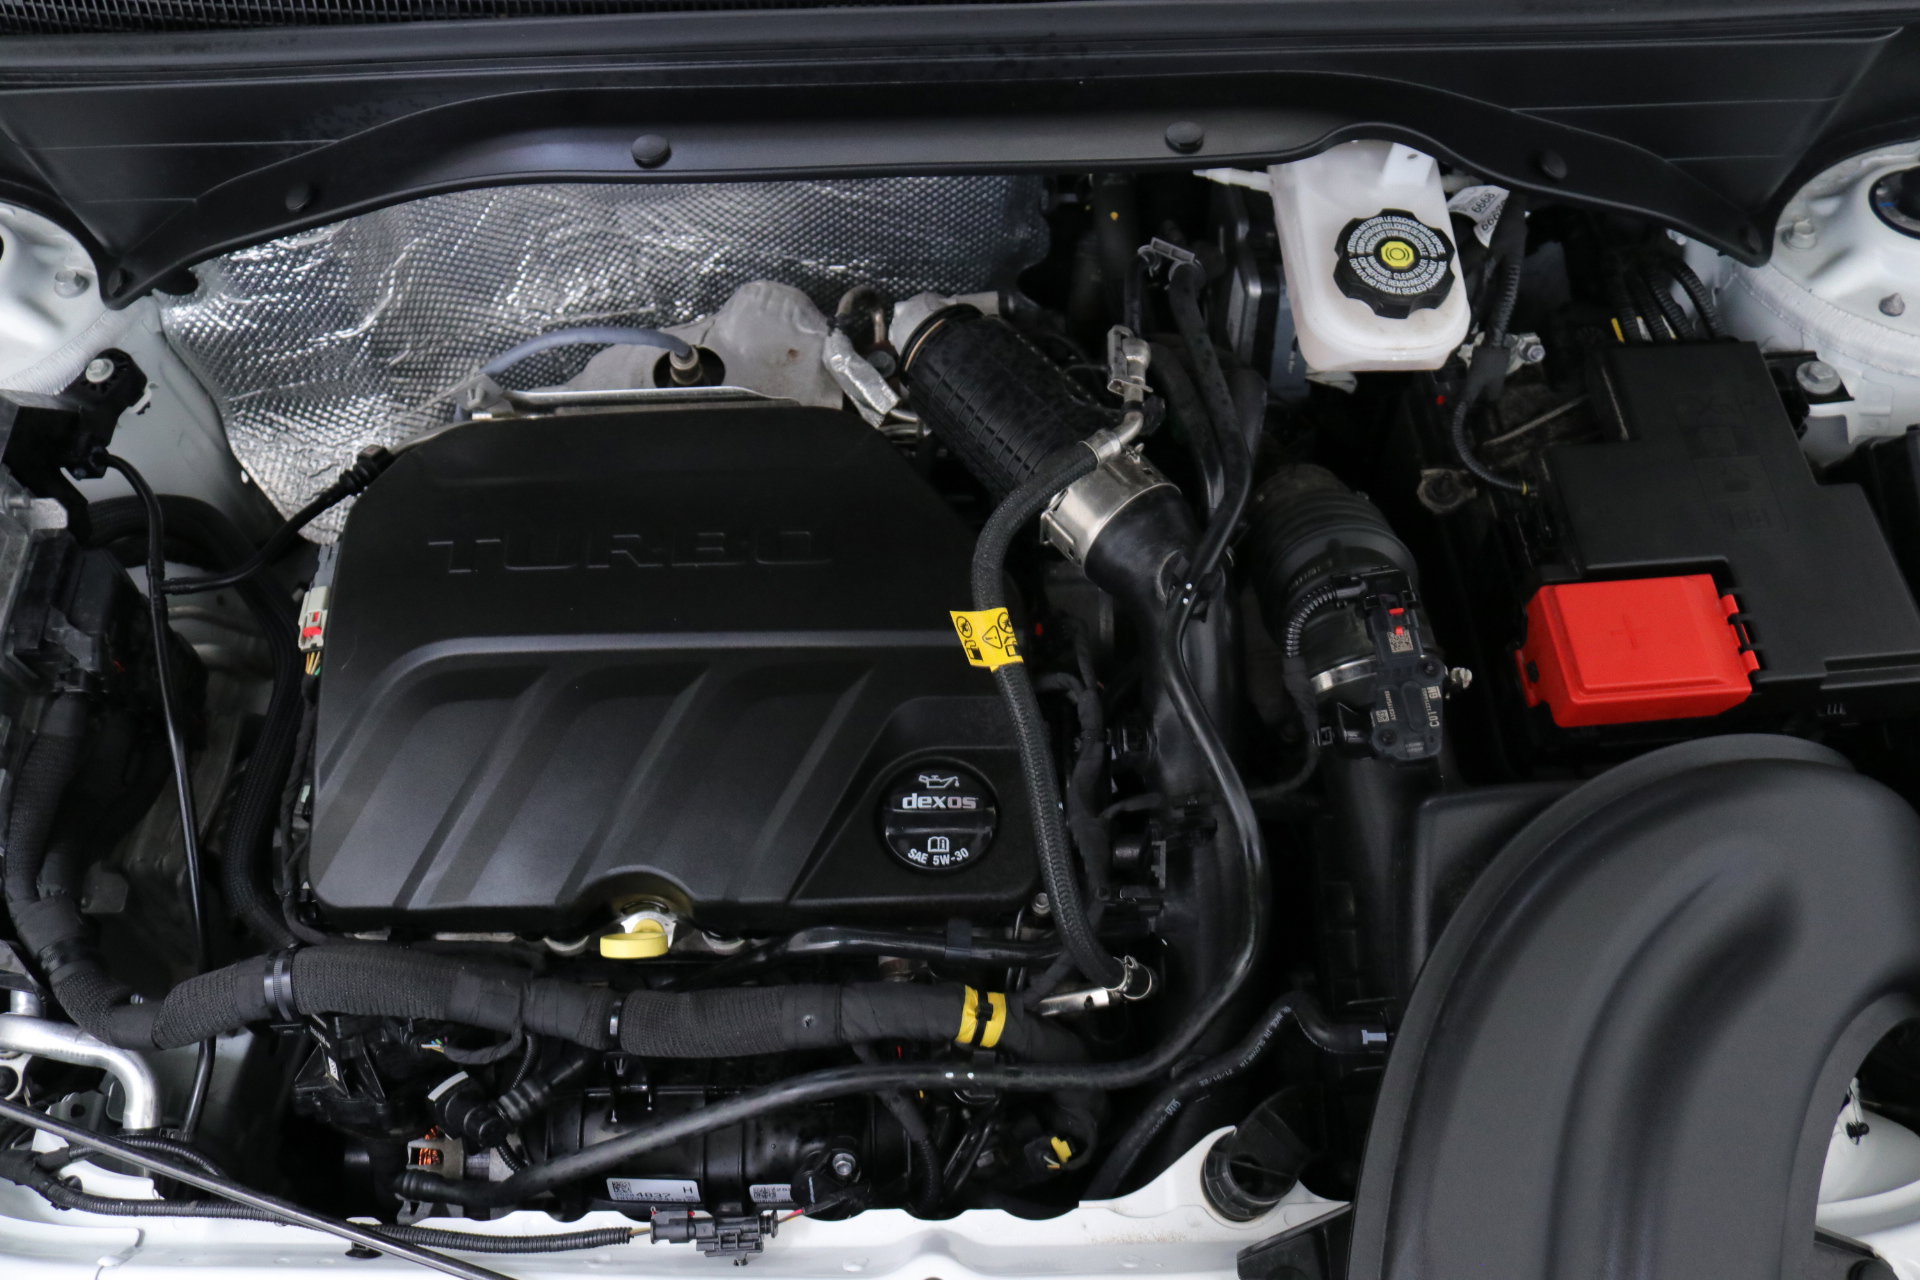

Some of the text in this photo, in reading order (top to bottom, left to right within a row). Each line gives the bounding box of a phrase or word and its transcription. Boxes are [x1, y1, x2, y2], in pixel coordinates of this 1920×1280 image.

[1364, 267, 1388, 283] BEFORE
[1393, 272, 1415, 284] CLEAN
[1376, 282, 1396, 293] FROM
[1396, 287, 1402, 295] A
[1401, 284, 1427, 295] SEALED
[427, 529, 834, 574] TURBO
[902, 793, 977, 809] dexos
[907, 847, 970, 866] SAE 5W-30
[683, 1186, 693, 1194] H
